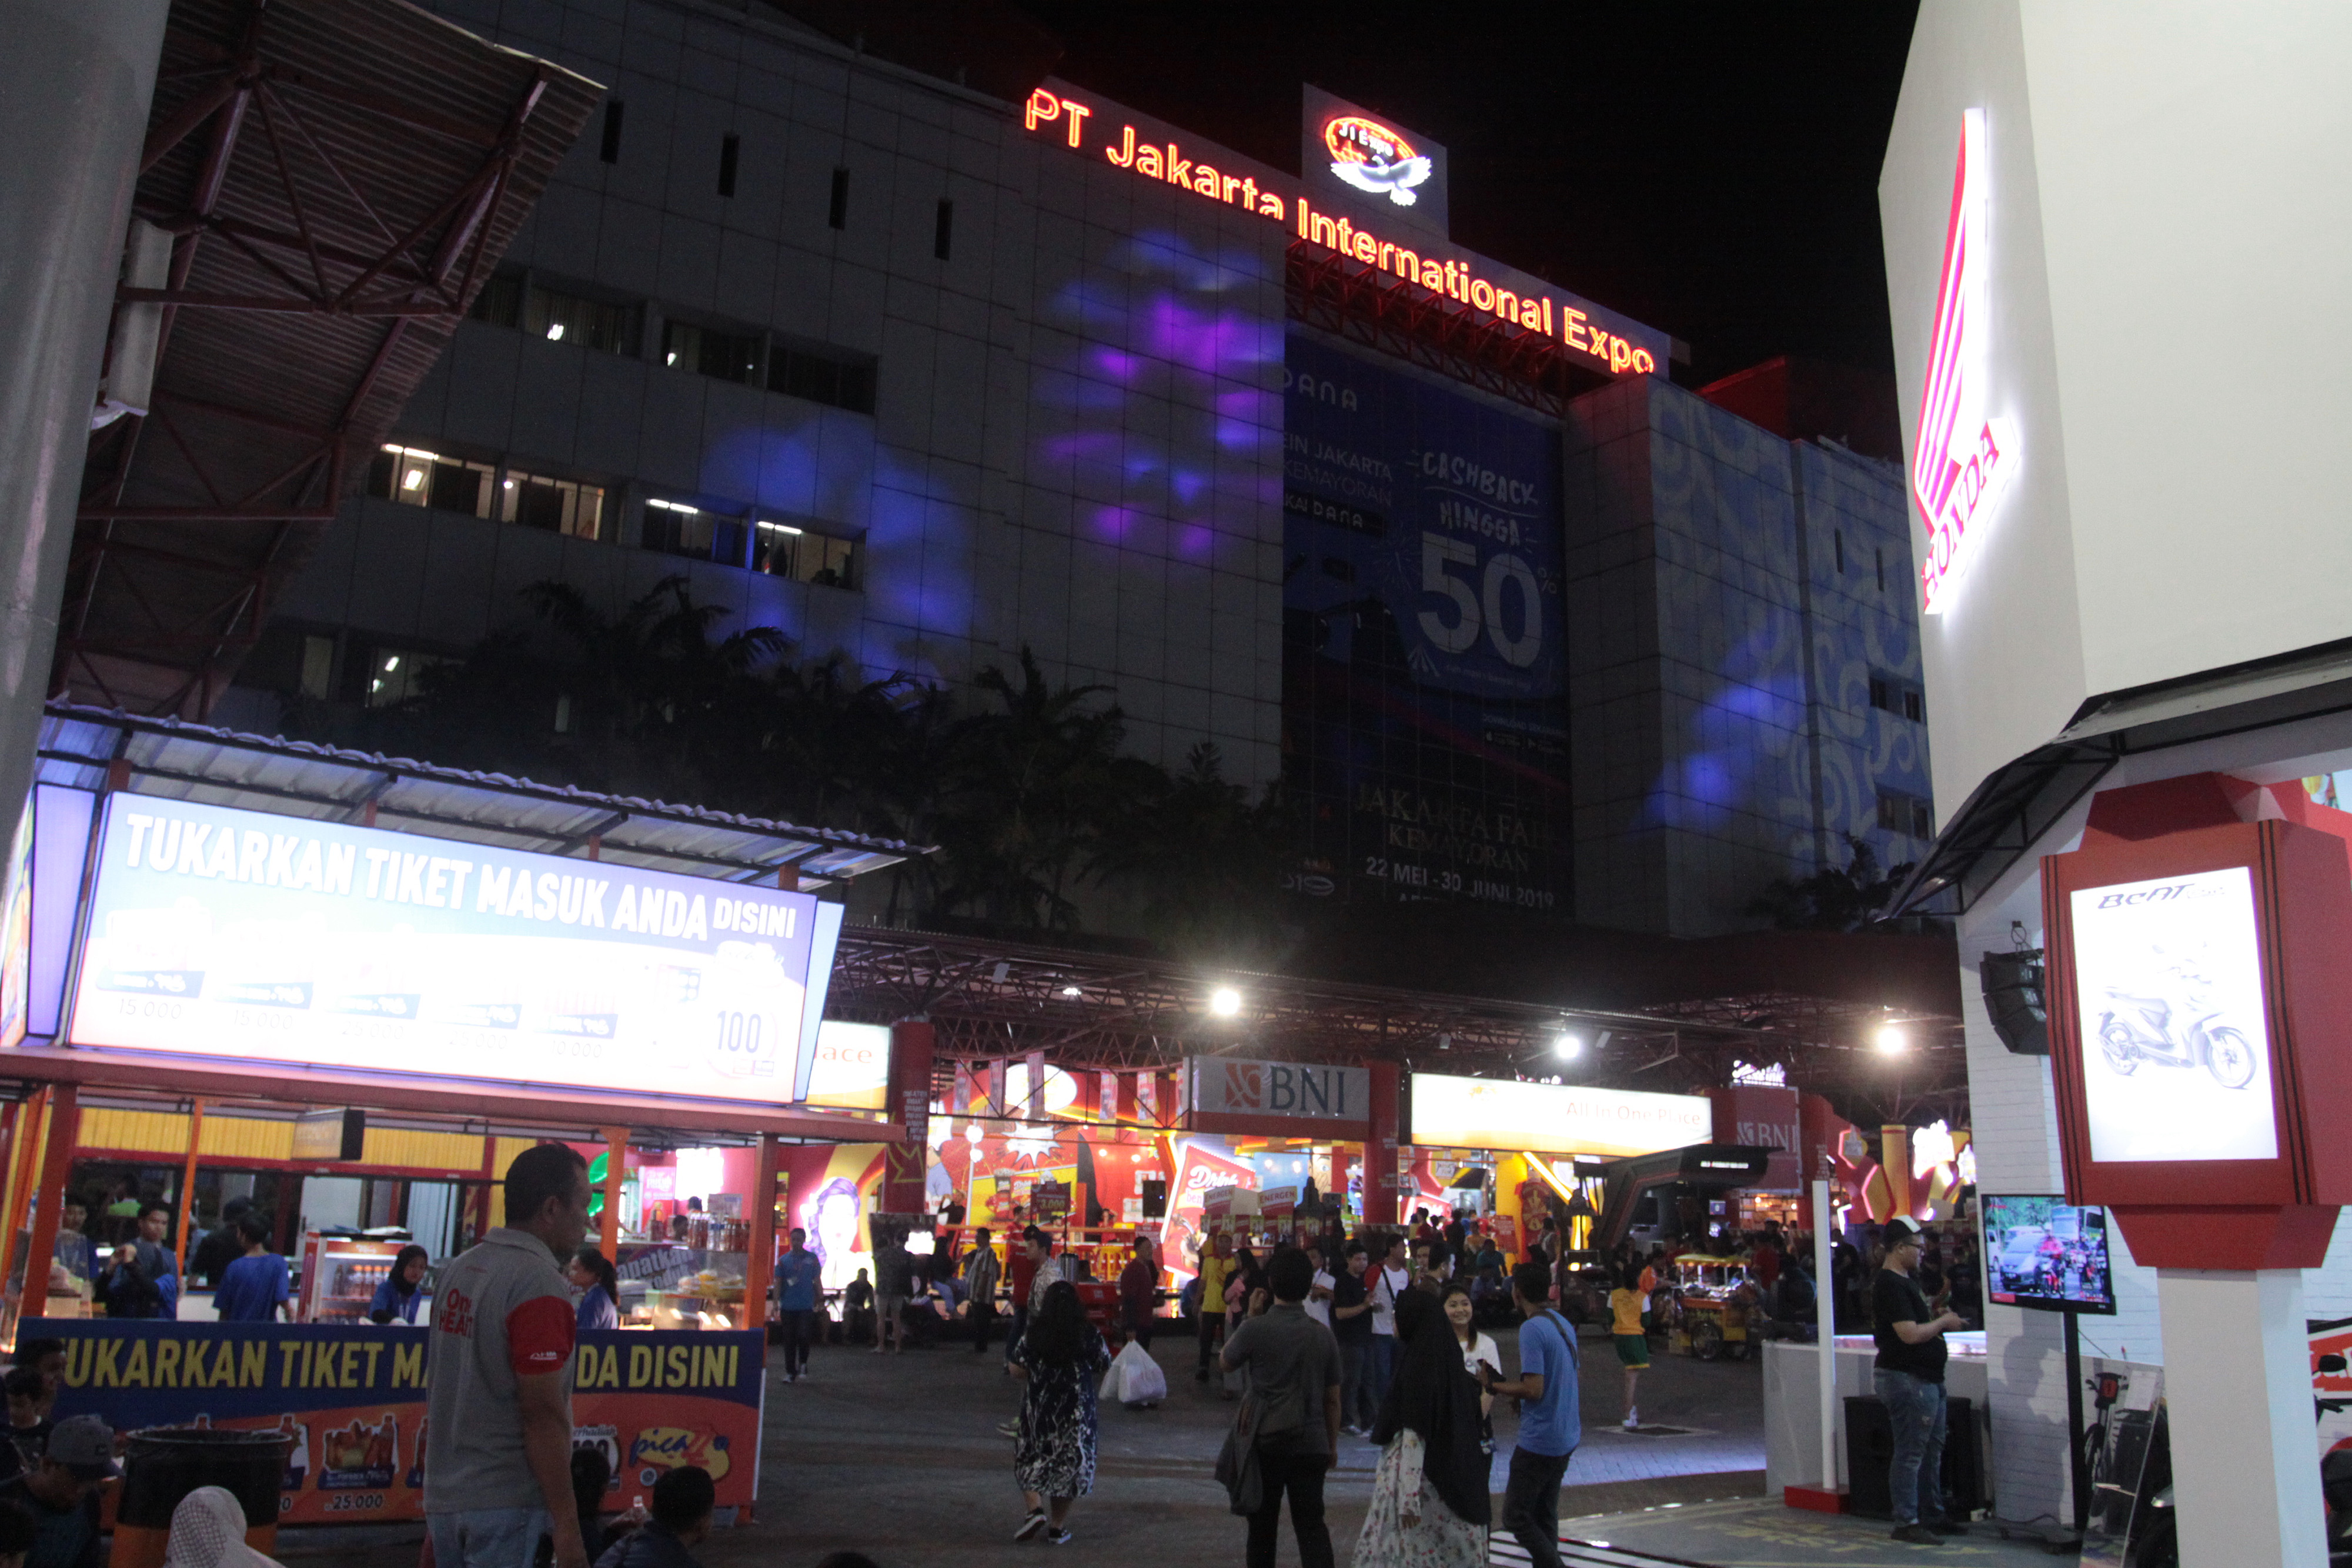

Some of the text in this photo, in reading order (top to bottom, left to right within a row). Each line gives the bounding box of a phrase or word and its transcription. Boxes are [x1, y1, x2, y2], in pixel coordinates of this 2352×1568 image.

[1025, 88, 1655, 375] PT Jakarta International Expo
[1314, 443, 1394, 484] JAKARTA
[1422, 449, 1539, 507] CASHBACK
[1439, 497, 1522, 549] HINGGA
[1921, 420, 2000, 614] HONDA
[126, 813, 798, 941] TUKARKAN TIKET MASUK ANDA DISINI
[1365, 856, 1388, 878] 22
[1394, 862, 1428, 888] MEI
[1441, 871, 1461, 892] 30
[1470, 878, 1512, 903] JUNI
[1516, 886, 1554, 910] 2019
[717, 1009, 762, 1054] 100
[1270, 1065, 1345, 1115] BNI
[1566, 1101, 1701, 1126] All In One Place
[1758, 1123, 1797, 1153] BNI
[1260, 1191, 1296, 1204] ENERGEN
[447, 1288, 472, 1313] On
[279, 1341, 385, 1389] TIKET
[391, 1343, 428, 1389] M
[629, 1344, 739, 1388] DISINI
